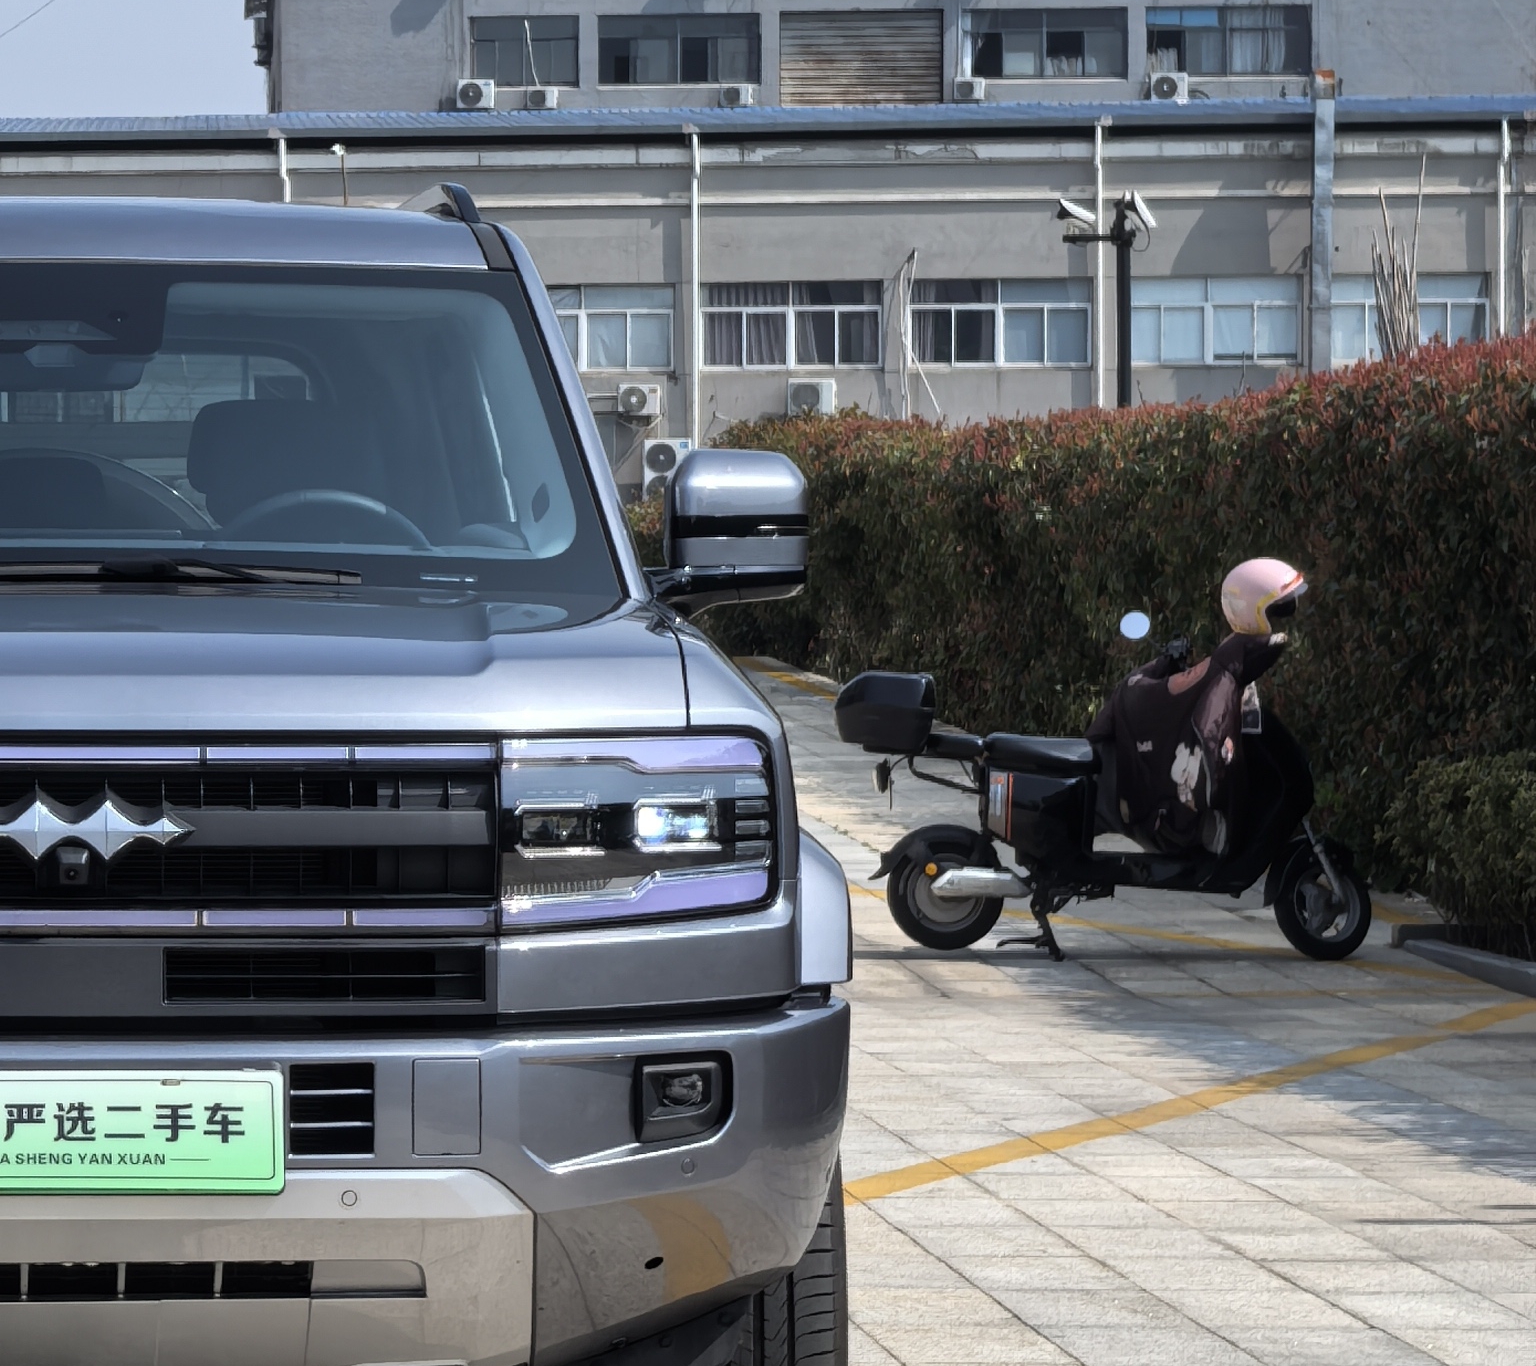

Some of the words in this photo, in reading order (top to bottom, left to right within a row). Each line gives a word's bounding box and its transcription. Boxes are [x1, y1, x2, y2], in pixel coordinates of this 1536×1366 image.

[15, 1153, 73, 1165] SHENG
[78, 1153, 113, 1165] YAN
[117, 1153, 166, 1165] XUAN
